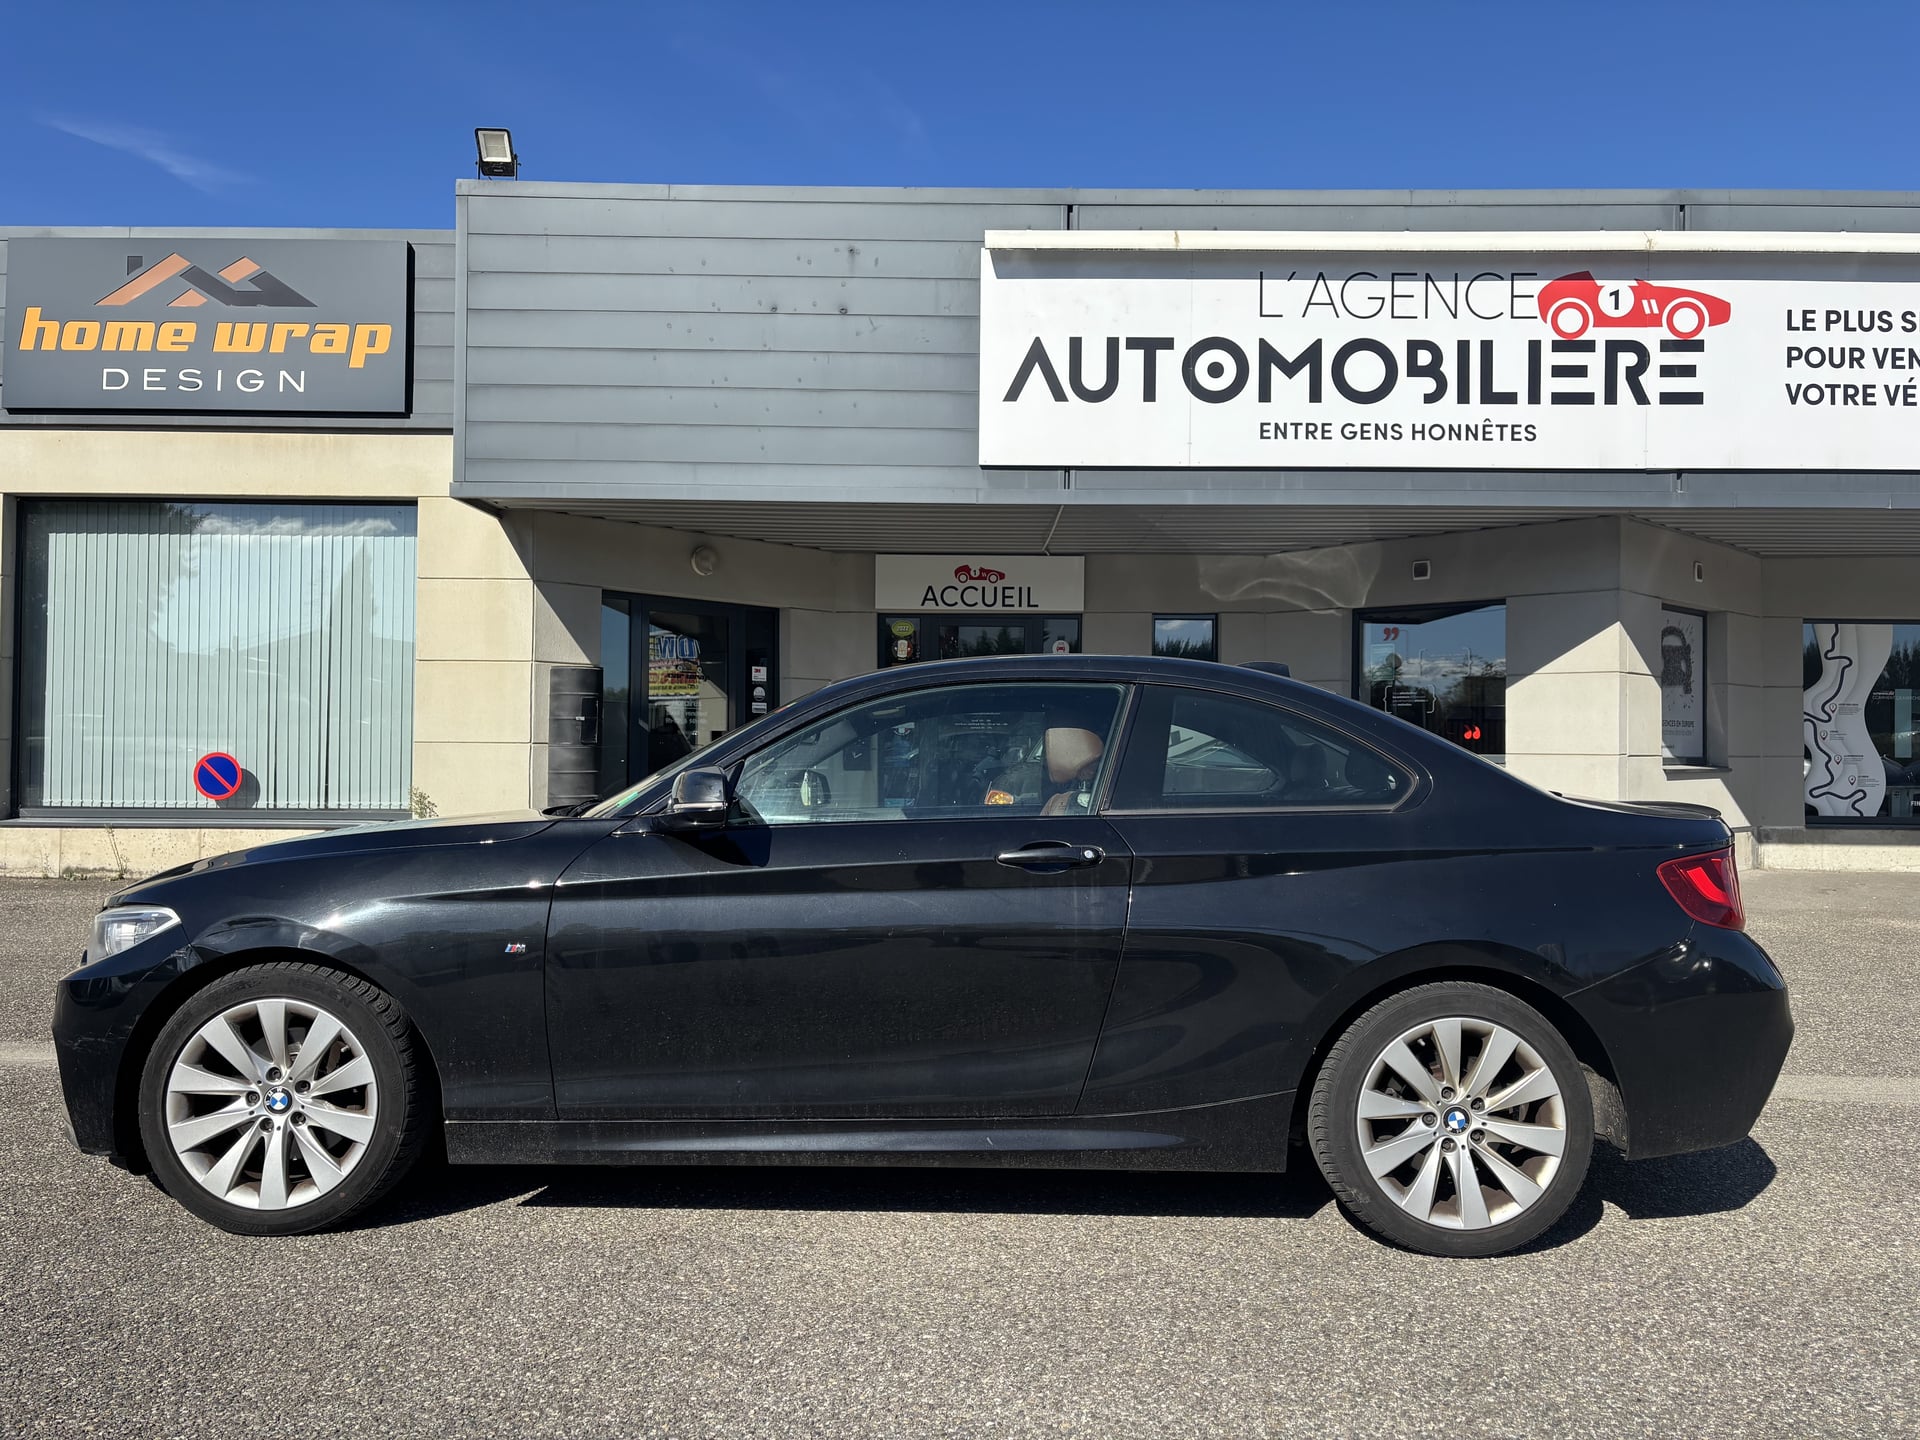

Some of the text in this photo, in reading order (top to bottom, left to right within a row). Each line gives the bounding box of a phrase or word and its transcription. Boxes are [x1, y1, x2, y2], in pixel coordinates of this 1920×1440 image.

[1608, 288, 1621, 311] 1
[1787, 309, 1920, 333] LE PLUS S
[19, 307, 392, 368] home wrap
[1786, 346, 1865, 369] POUR
[102, 368, 305, 393] DESIGN
[1785, 383, 1877, 406] VOTRE
[1259, 418, 1538, 442] ENTRE GENS HONNÊTES
[921, 585, 1039, 608] ACCUEIL
